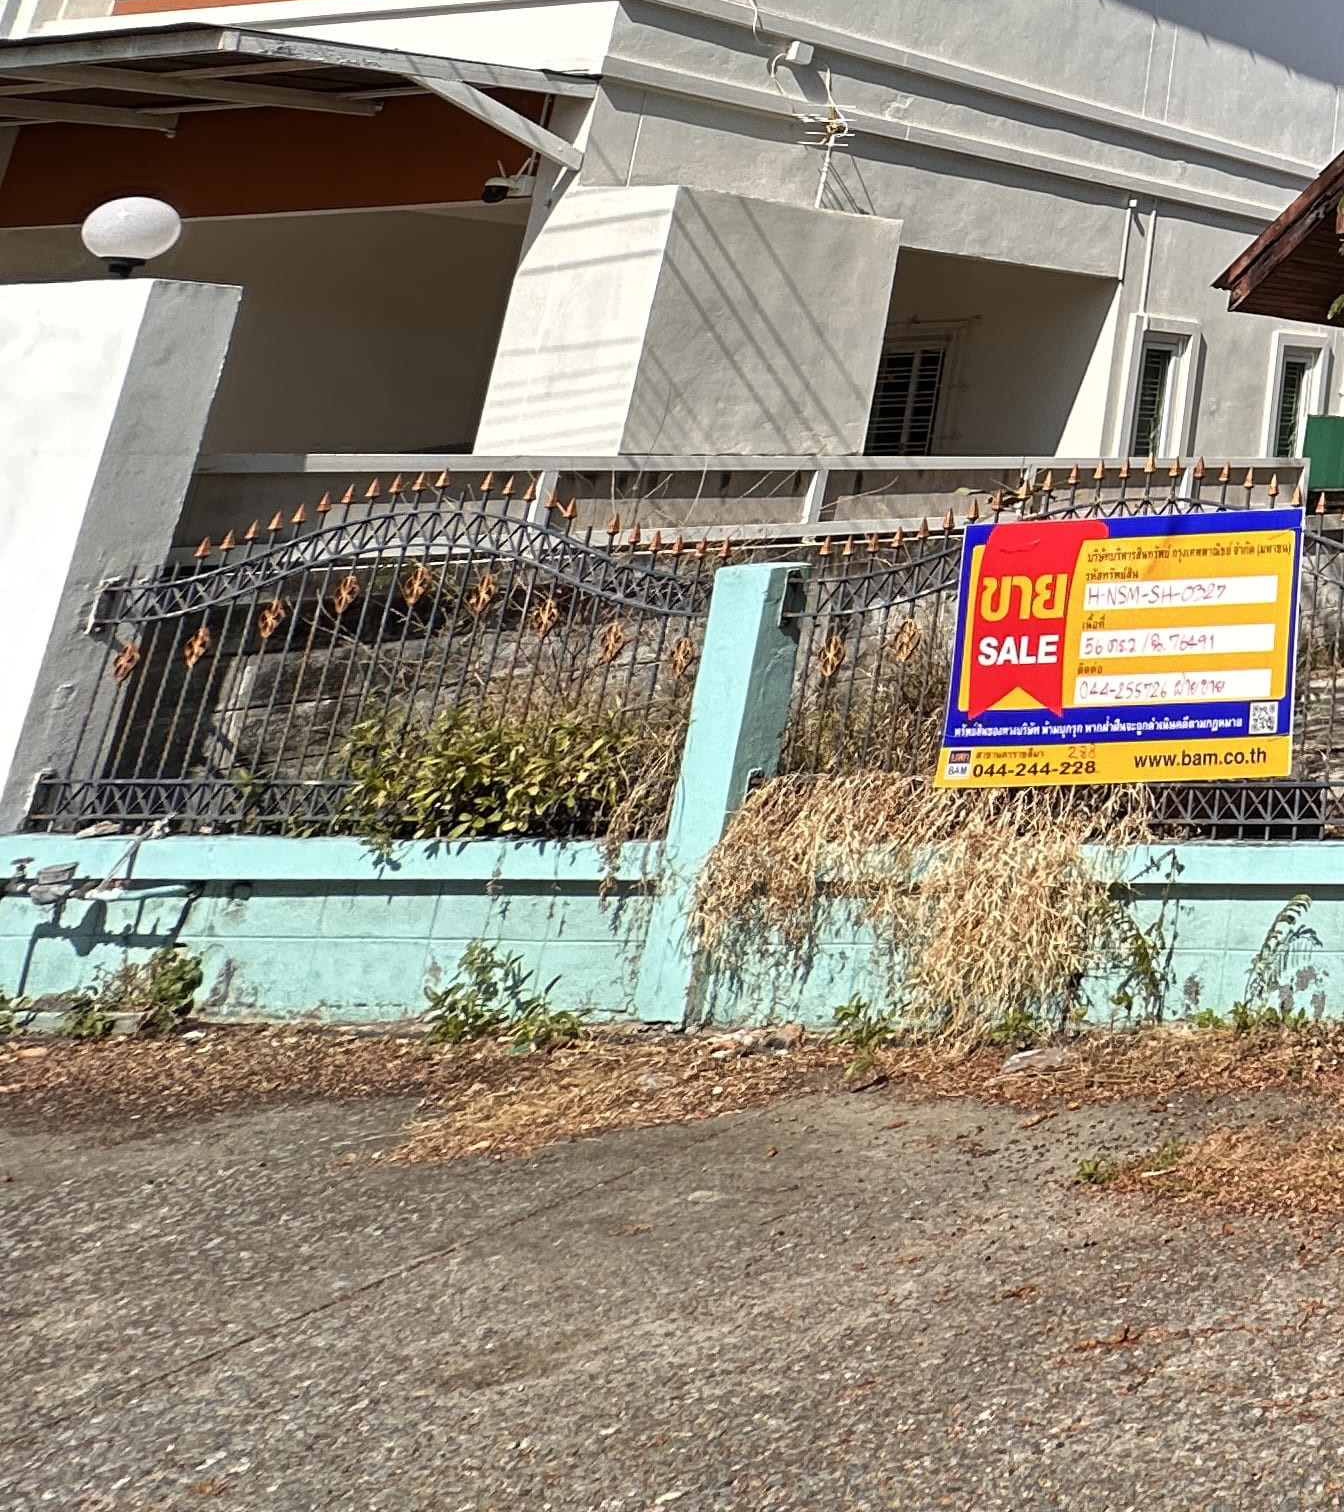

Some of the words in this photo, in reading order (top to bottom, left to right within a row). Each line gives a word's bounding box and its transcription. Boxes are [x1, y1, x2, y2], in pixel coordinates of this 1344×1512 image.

[979, 573, 1069, 622] ขาย
[1081, 612, 1106, 629] เนื้อที่
[977, 633, 1060, 666] SALE
[1084, 637, 1103, 655] 56
[1077, 661, 1103, 675] ติดต่อ
[1133, 747, 1268, 769] www.bam.co.th
[947, 765, 968, 776] BAM
[972, 760, 1097, 778] 044-244-228
